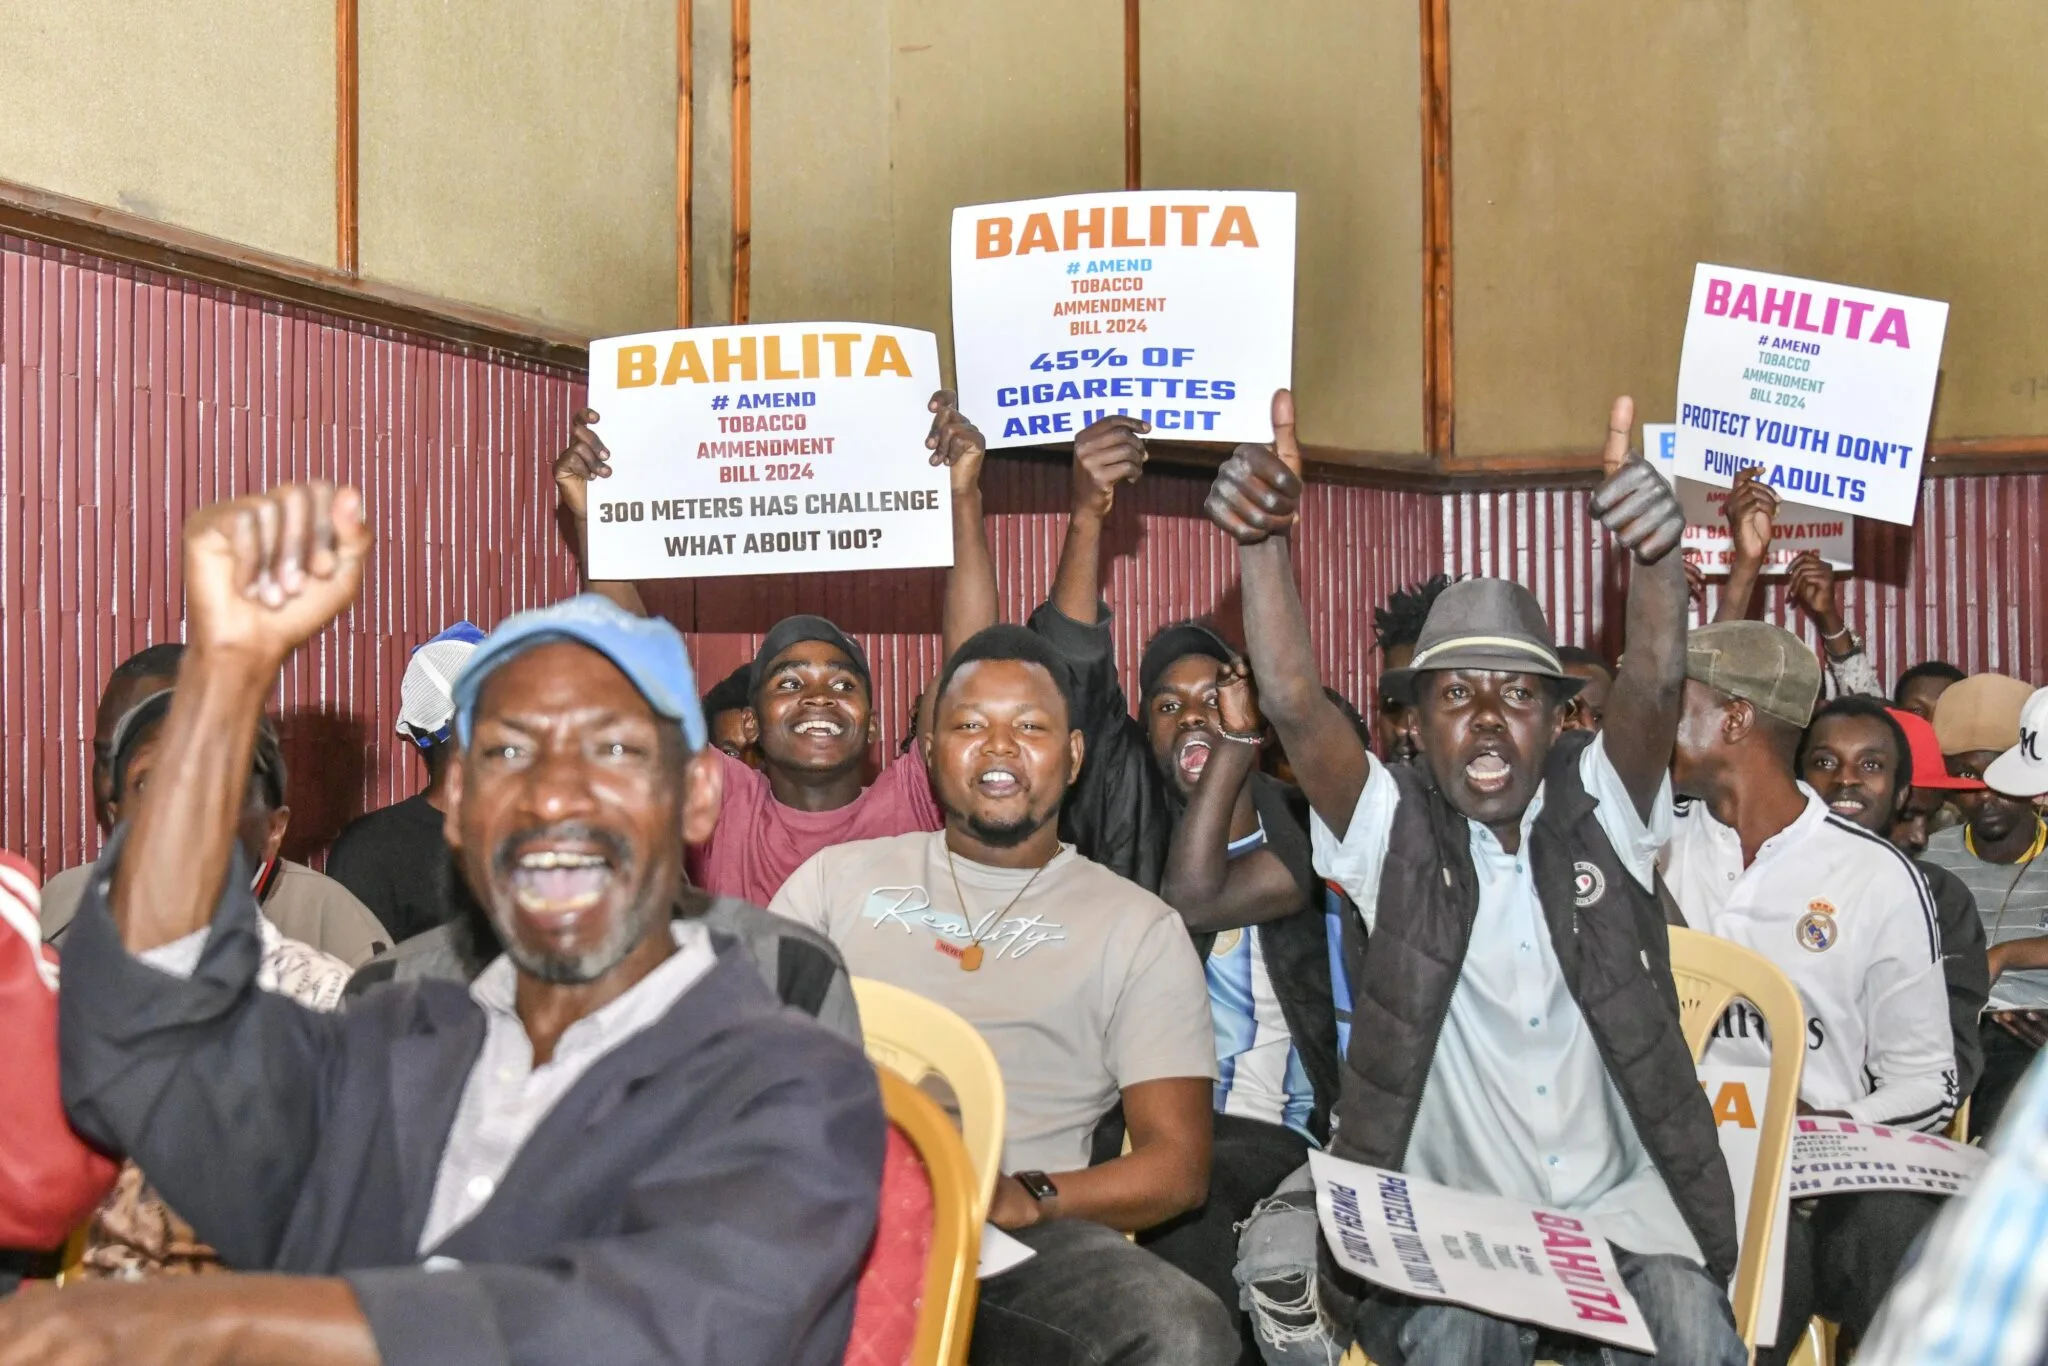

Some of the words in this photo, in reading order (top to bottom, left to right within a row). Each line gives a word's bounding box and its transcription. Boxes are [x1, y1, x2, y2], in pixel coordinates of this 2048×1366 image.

[976, 205, 1259, 259] BAHLITA
[1067, 262, 1080, 274] #
[1087, 259, 1152, 273] AMEND
[1071, 277, 1143, 294] TOBACCO
[1053, 298, 1166, 316] AMMENDMENT
[1704, 278, 1910, 349] BAHLITA
[1070, 320, 1101, 336] BILL
[1106, 319, 1147, 333] 2024
[1759, 335, 1768, 345] #
[1772, 337, 1820, 355] AMEND
[617, 333, 912, 389] BAHLITA
[1030, 348, 1128, 372] 45%
[1143, 348, 1195, 367] OF
[1759, 351, 1810, 372] TOBACCO
[997, 378, 1235, 407] CIGARETTES
[1743, 368, 1825, 393] AMMENDMENT
[711, 395, 729, 410] #
[737, 392, 815, 409] AMEND
[1750, 388, 1771, 403] BILL
[1775, 392, 1805, 409] 2024
[718, 414, 806, 433] TOBACCO
[1003, 412, 1072, 438] ARE
[1682, 403, 1750, 437] PROTECT
[1756, 418, 1829, 454] YOUTH
[1836, 434, 1913, 468] DON'T
[697, 437, 835, 459] AMMENDMENT
[720, 465, 760, 483] BILL
[765, 463, 814, 481] 2024
[1768, 464, 1867, 503] ADULTS
[600, 502, 644, 523] 300
[652, 497, 743, 521] METERS
[750, 495, 798, 516] HAS
[805, 490, 939, 514] CHALLENGE
[664, 534, 736, 557] WHAT
[743, 531, 820, 553] ABOUT
[827, 529, 882, 550] 100?
[872, 885, 1065, 960] Reality
[1531, 1210, 1629, 1325] BAHLITA
